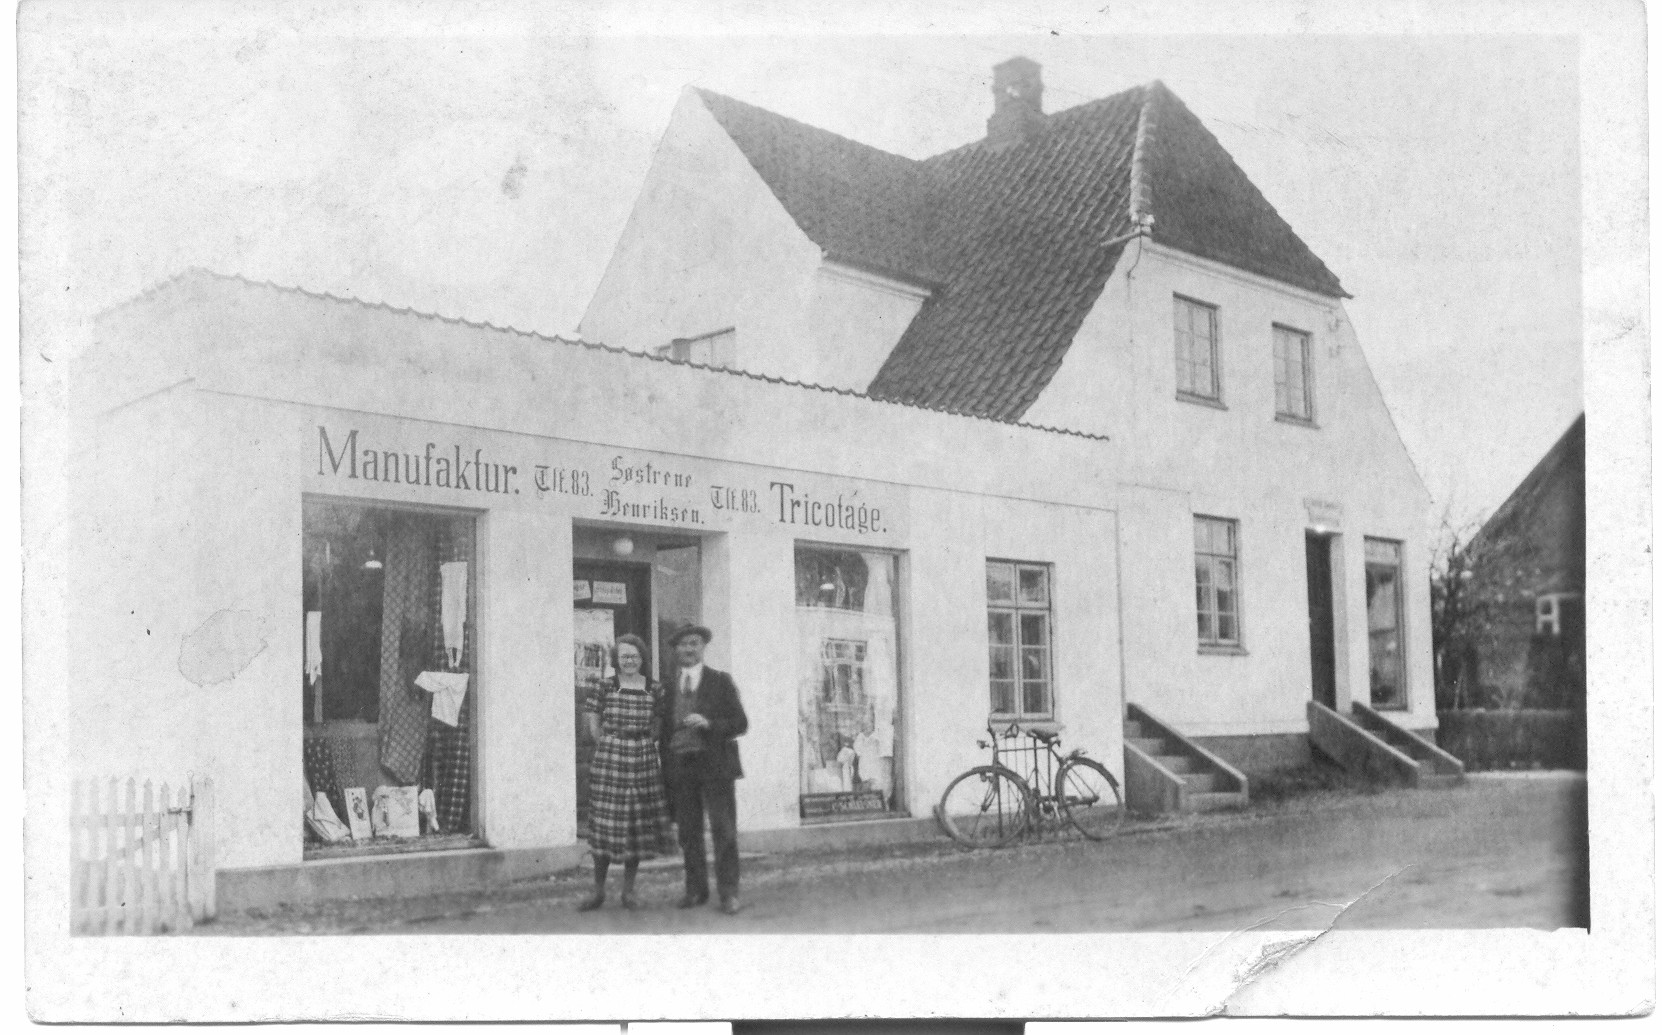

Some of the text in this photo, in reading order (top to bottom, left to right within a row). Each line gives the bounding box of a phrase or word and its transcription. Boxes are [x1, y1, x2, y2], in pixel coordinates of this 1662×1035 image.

[317, 425, 520, 495] Manufaktur.
[609, 455, 692, 487] Søstrene
[600, 488, 705, 525] Henriksen.
